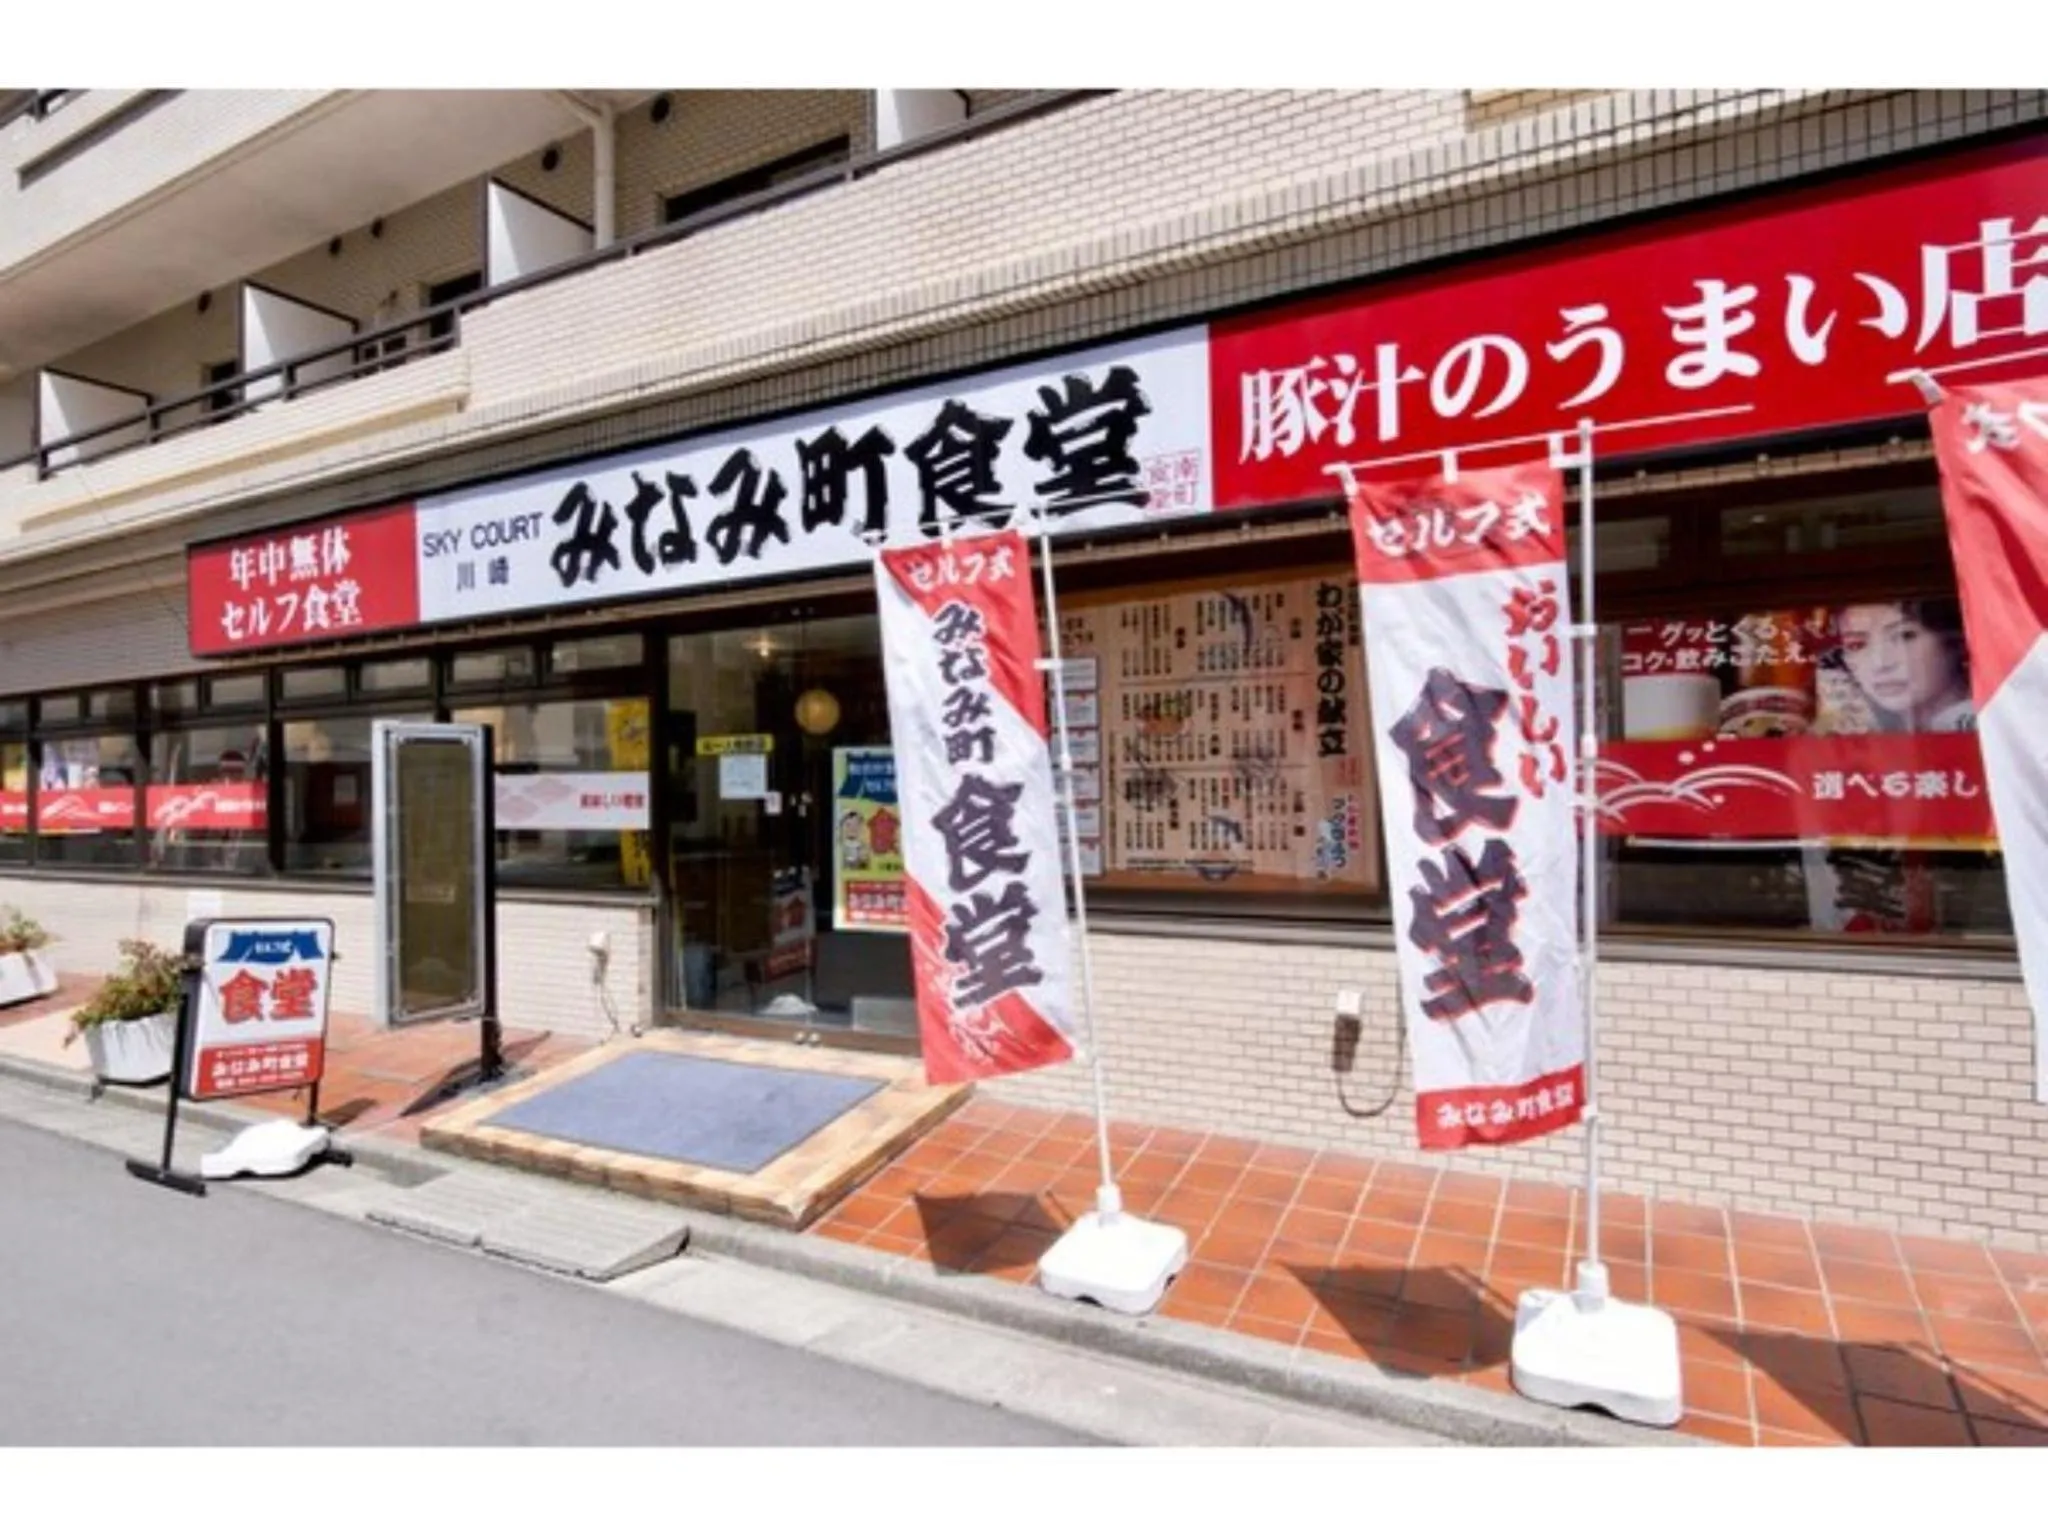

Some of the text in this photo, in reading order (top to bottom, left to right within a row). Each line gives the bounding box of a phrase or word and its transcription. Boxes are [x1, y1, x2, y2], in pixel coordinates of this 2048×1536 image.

[1240, 217, 2048, 463] 豚汁のうまい店
[551, 366, 1152, 587] みなみ町食堂
[423, 511, 543, 558] SKY COURT
[1364, 491, 1553, 558] セルフ式
[229, 527, 353, 591] 年中無休
[908, 547, 1016, 592] セルフ式
[221, 582, 363, 641] セルフ食堂
[1503, 577, 1568, 800] おいしい
[931, 602, 1044, 1009] みなみ町食堂
[1389, 667, 1530, 1022] 食堂
[218, 968, 318, 1025] 食堂
